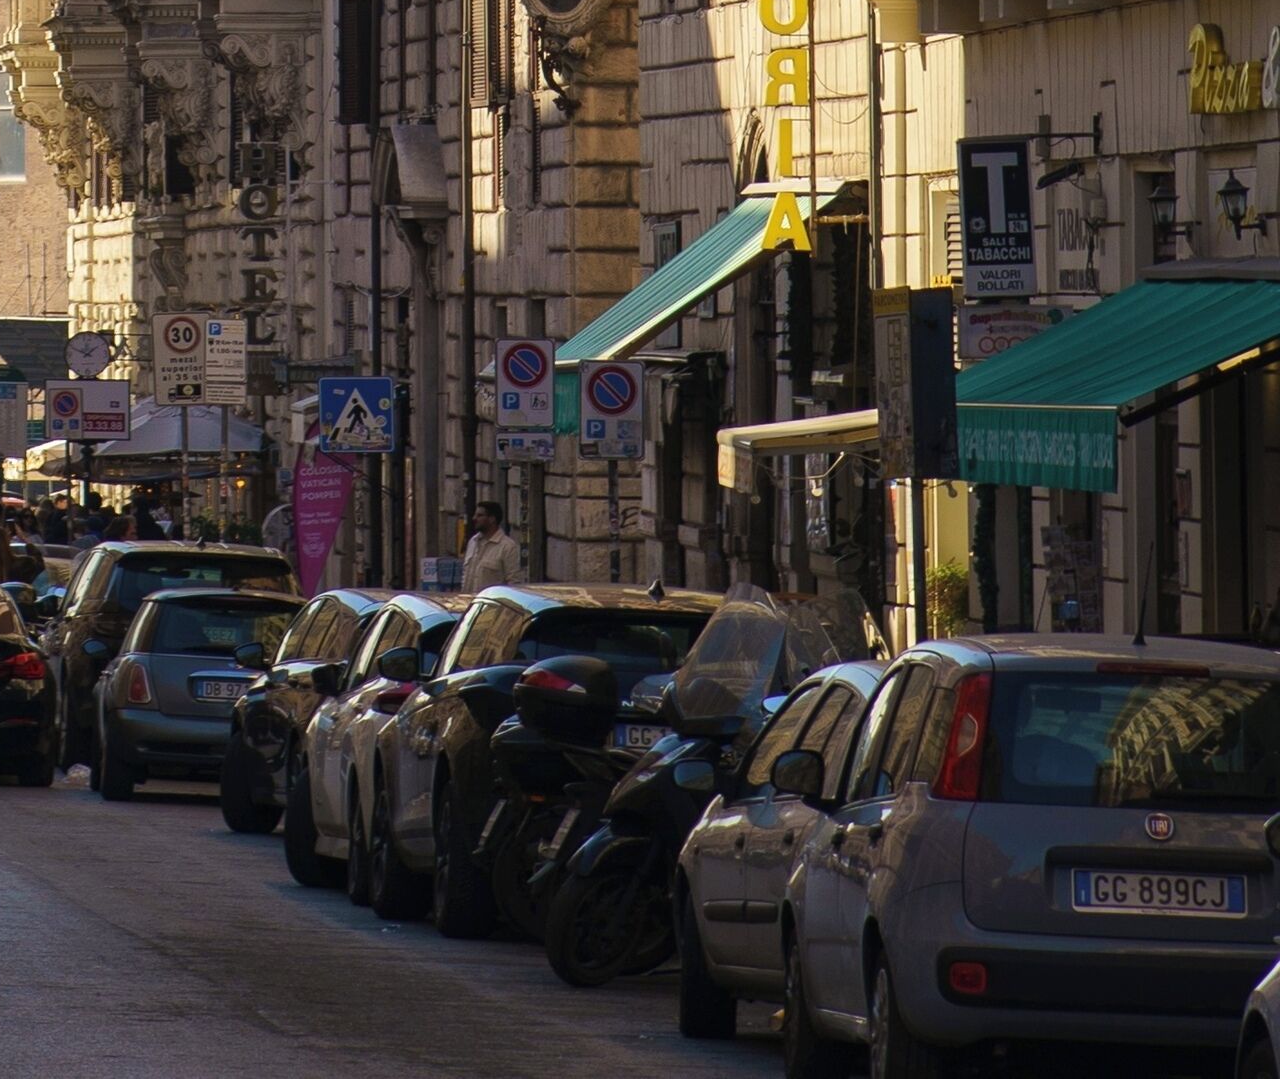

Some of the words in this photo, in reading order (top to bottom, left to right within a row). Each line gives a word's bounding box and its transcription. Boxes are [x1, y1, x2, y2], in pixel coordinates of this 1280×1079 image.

[1188, 23, 1251, 113] Pizza
[235, 141, 281, 345] HOTEL
[982, 237, 1006, 247] SALI
[1009, 237, 1016, 246] E
[969, 247, 1031, 261] TABACCHI
[980, 270, 1022, 280] VALORI
[977, 281, 1024, 291] BOLLATI
[171, 326, 193, 344] 30
[161, 365, 203, 374] superior
[300, 478, 342, 489] VATICAN
[1094, 874, 1128, 903] GG
[1138, 876, 1226, 908] 899CJ
